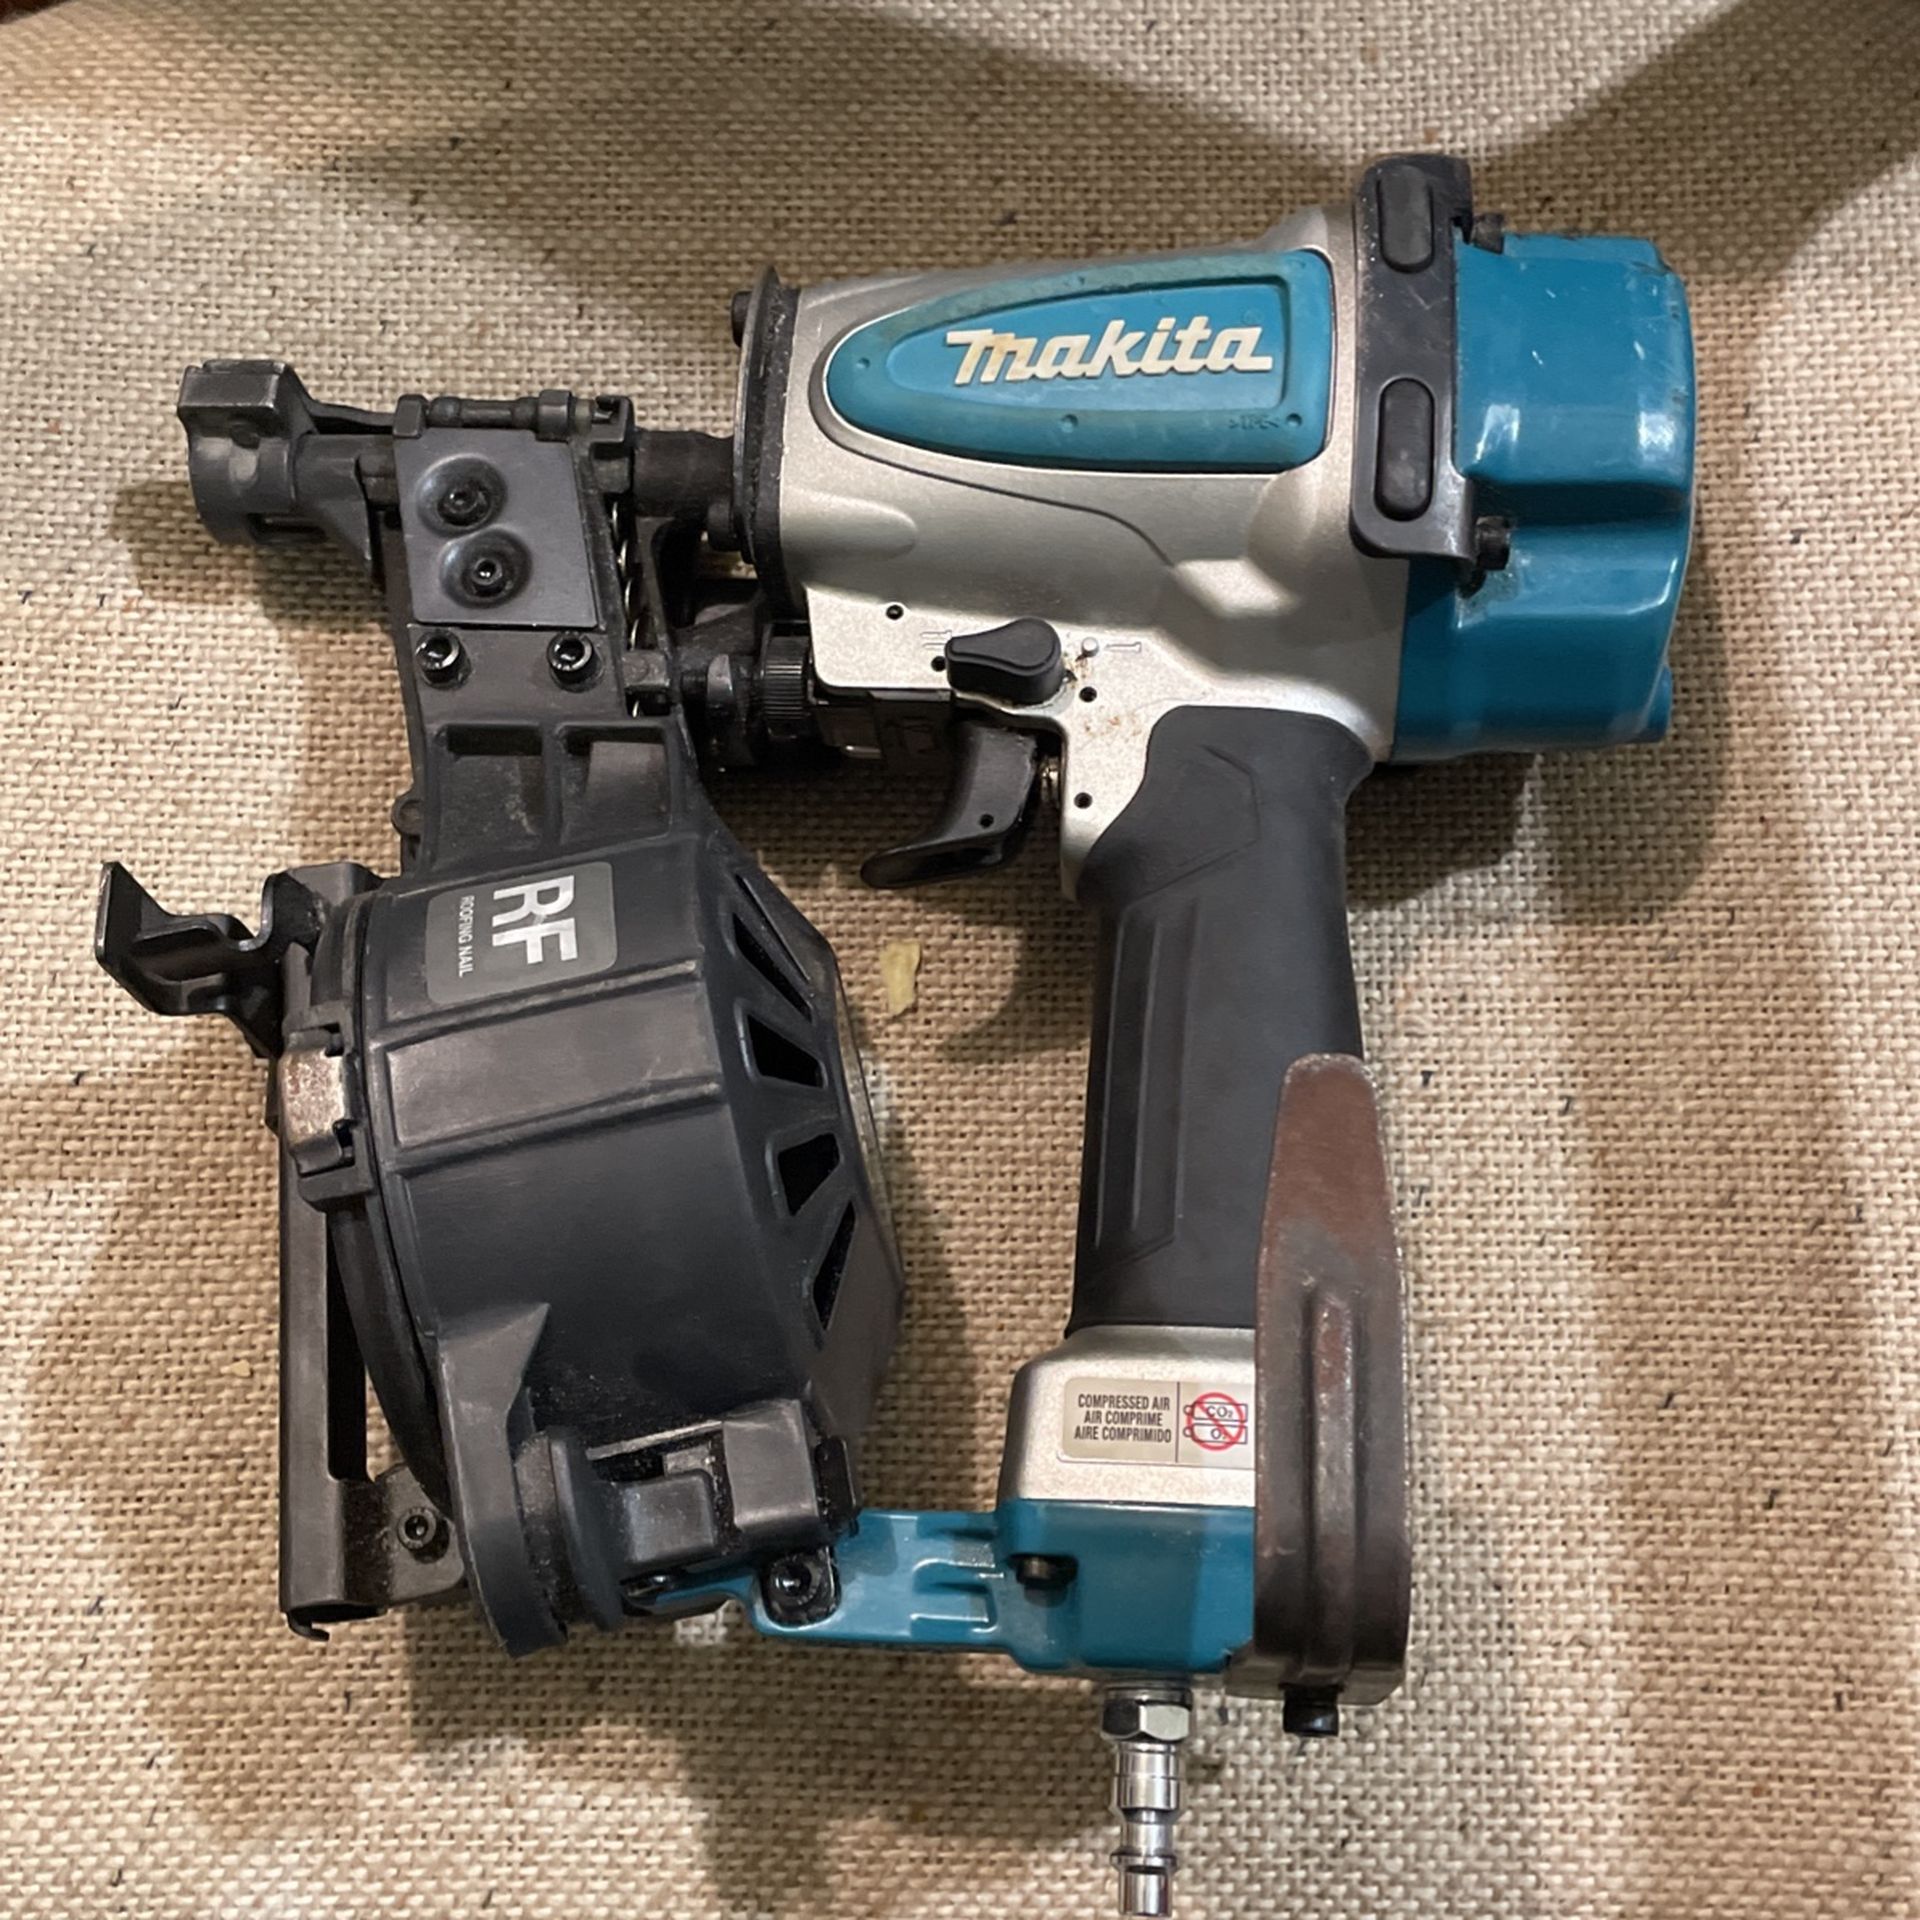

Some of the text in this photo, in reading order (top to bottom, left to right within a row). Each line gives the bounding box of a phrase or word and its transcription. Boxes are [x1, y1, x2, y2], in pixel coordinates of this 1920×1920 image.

[492, 875, 578, 964] RF
[458, 894, 475, 978] ROOFING NAIL
[1078, 1393, 1170, 1411] COMPRESSED AIR
[1083, 1410, 1102, 1424] AIR
[1074, 1425, 1172, 1443] AIRE COMPRIMIDO
